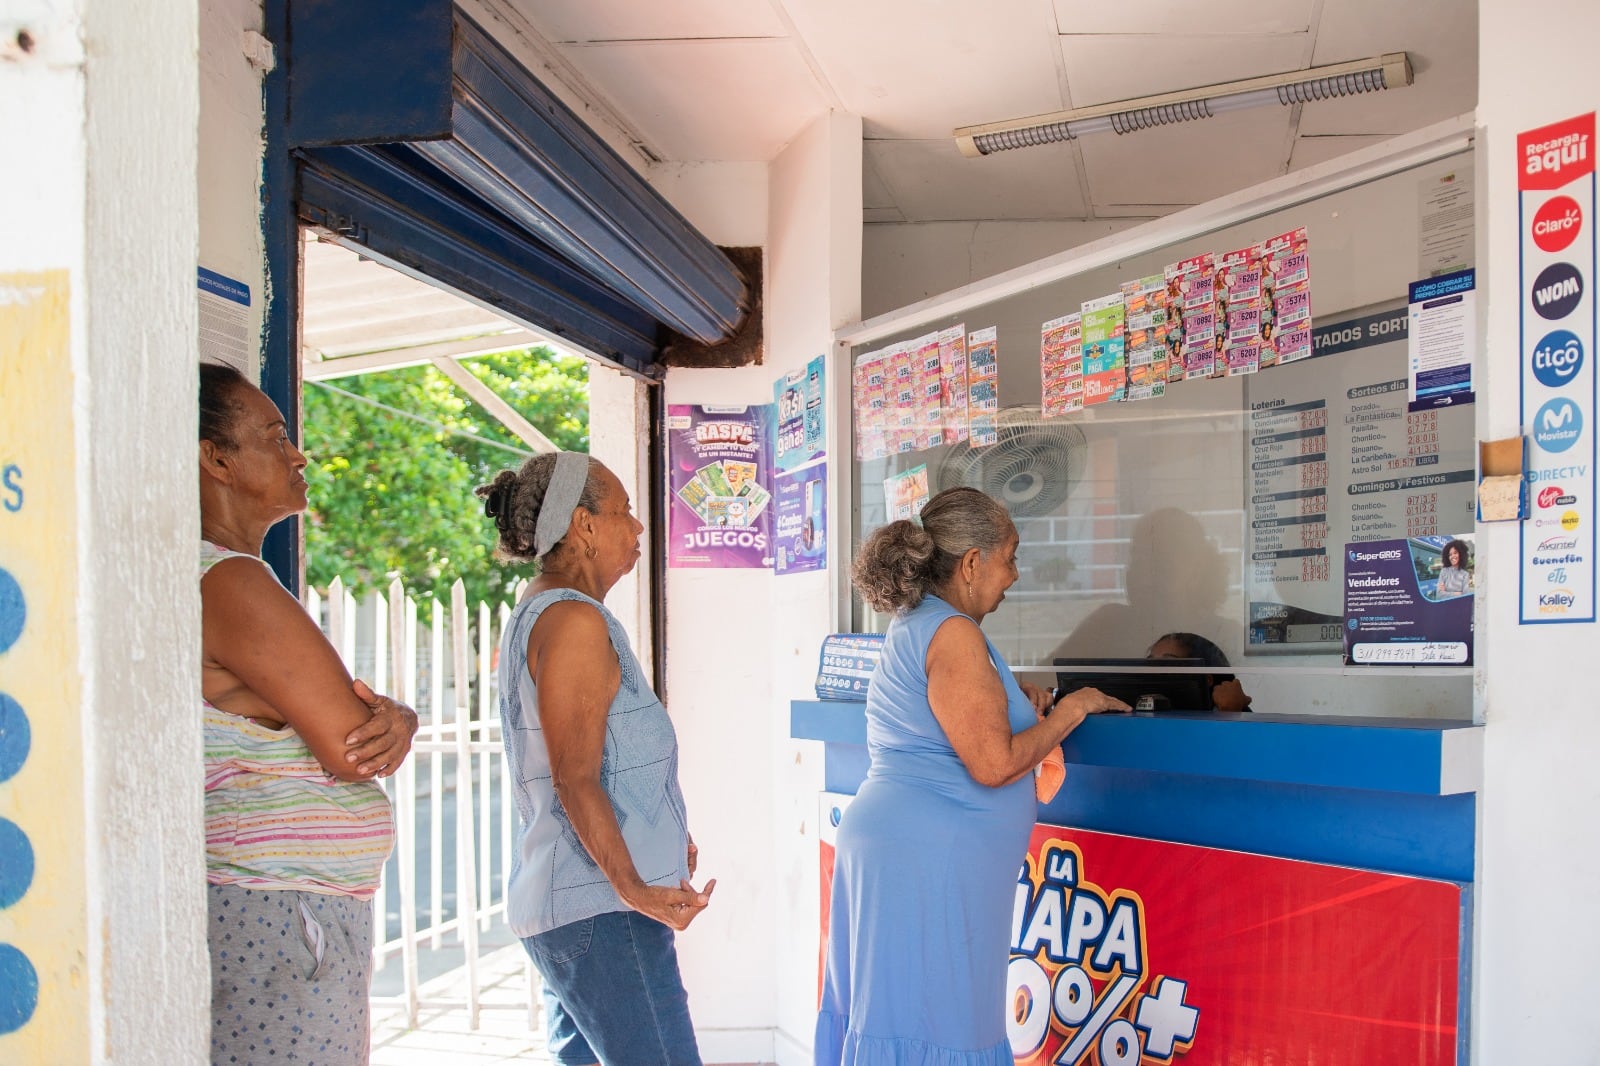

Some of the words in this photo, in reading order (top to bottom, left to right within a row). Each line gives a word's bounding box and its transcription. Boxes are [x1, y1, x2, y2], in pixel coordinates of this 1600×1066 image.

[1526, 133, 1580, 155] Recarga
[1526, 135, 1589, 174] aquí
[1535, 212, 1576, 236] Claro
[1536, 276, 1579, 306] WOM
[1313, 326, 1362, 349] TADOS
[1536, 344, 1579, 370] tigo
[1351, 385, 1388, 398] Sorteos
[1351, 403, 1376, 412] Dorado
[1345, 415, 1355, 424] La
[696, 423, 753, 443] RASPA
[1538, 429, 1578, 442] Movistar
[1351, 456, 1360, 464] La
[1351, 466, 1370, 475] Astro
[1371, 464, 1382, 473] Sol
[1351, 481, 1395, 492] Domingos
[1397, 481, 1402, 489] y
[1405, 475, 1446, 486] Festivos
[1351, 524, 1360, 532] La
[1356, 550, 1401, 562] SuperGIROS
[1348, 576, 1400, 588] Vendedores
[1539, 594, 1575, 607] Kalley
[1048, 854, 1073, 882] LA
